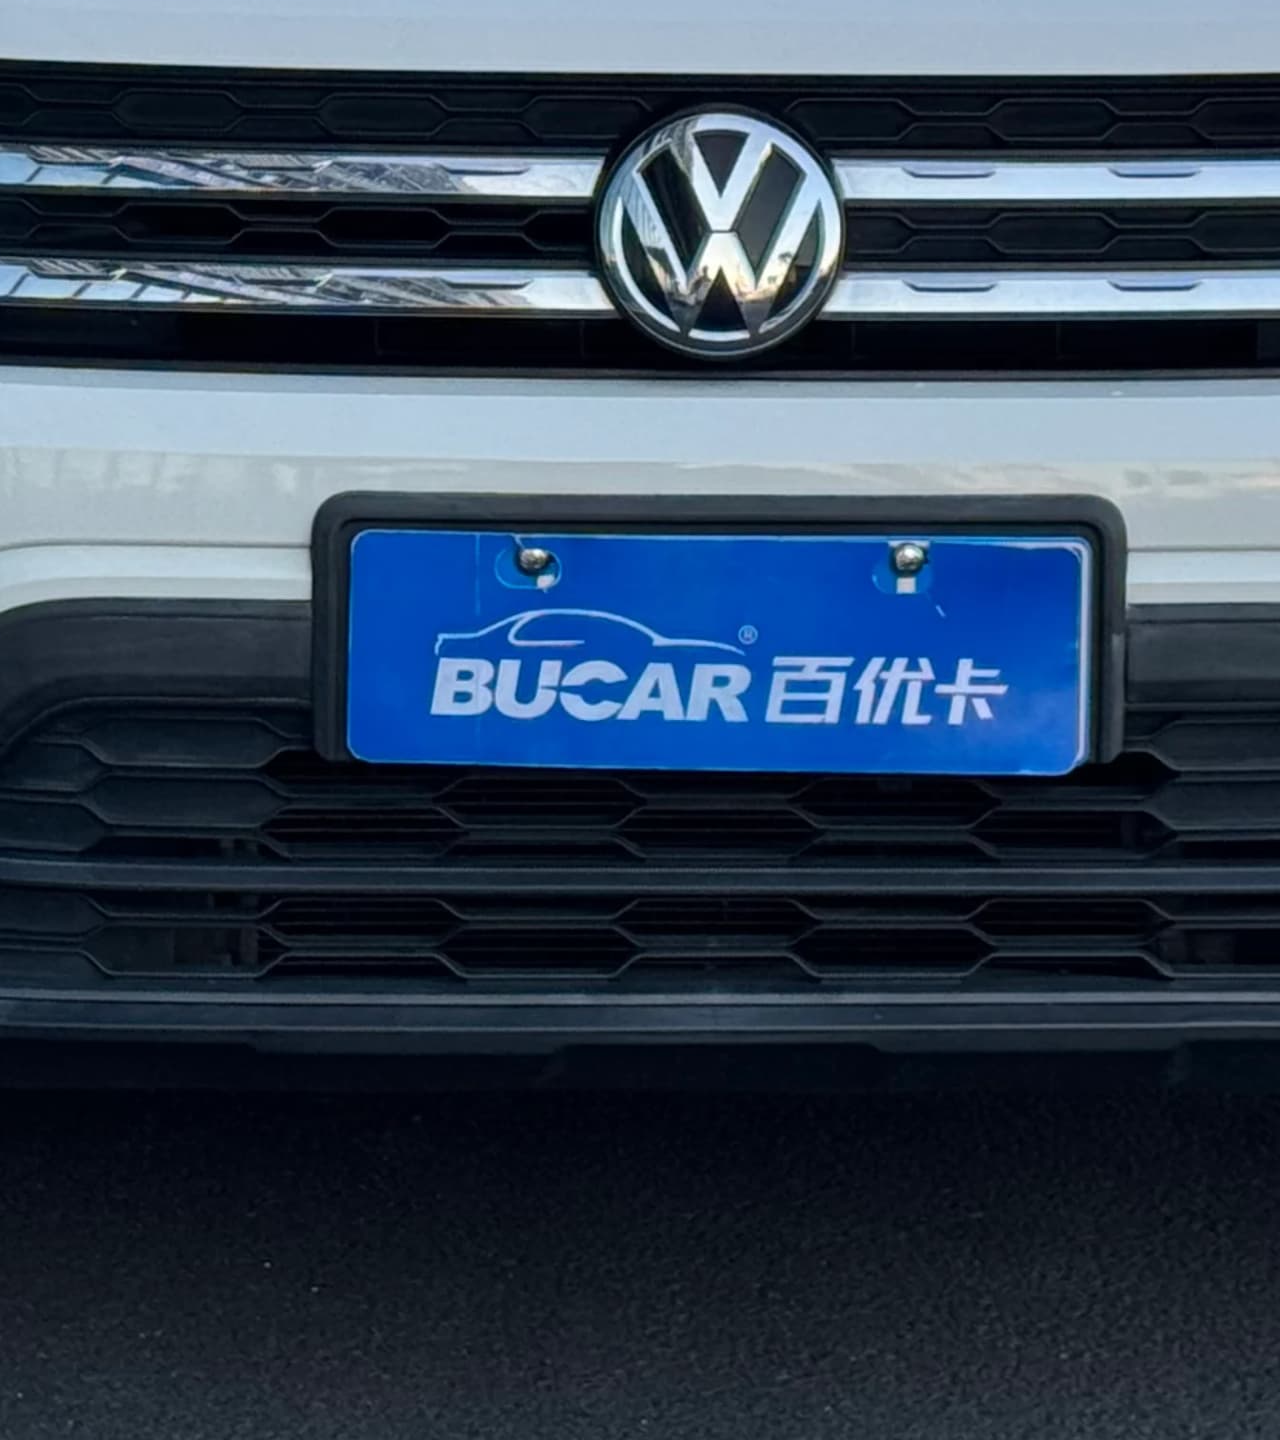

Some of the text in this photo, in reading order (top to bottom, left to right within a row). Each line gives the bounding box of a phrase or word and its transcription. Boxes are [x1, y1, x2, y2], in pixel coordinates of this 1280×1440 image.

[430, 656, 1008, 725] BUCAR 百优卡
